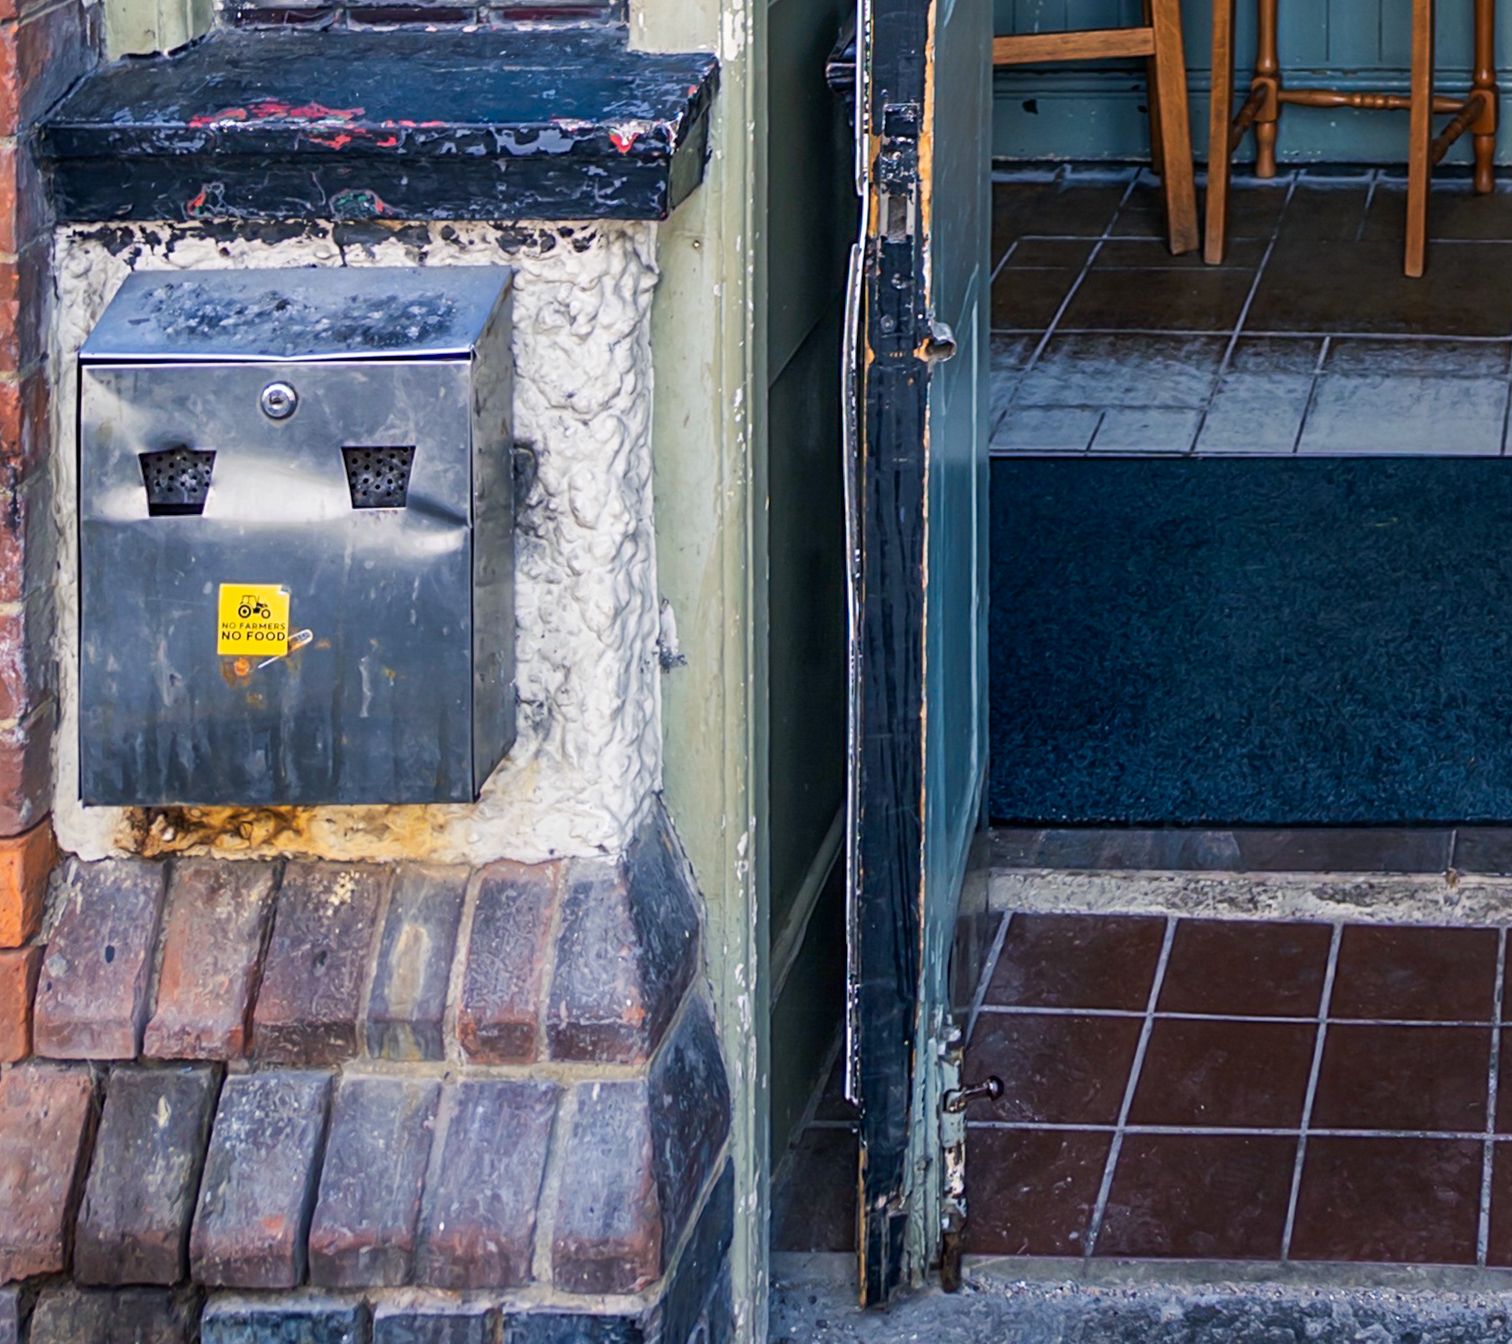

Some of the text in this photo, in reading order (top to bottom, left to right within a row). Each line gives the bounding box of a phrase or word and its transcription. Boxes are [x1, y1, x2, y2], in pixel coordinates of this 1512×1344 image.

[221, 622, 286, 631] NO FARMERS
[221, 631, 286, 642] NO FOOD
